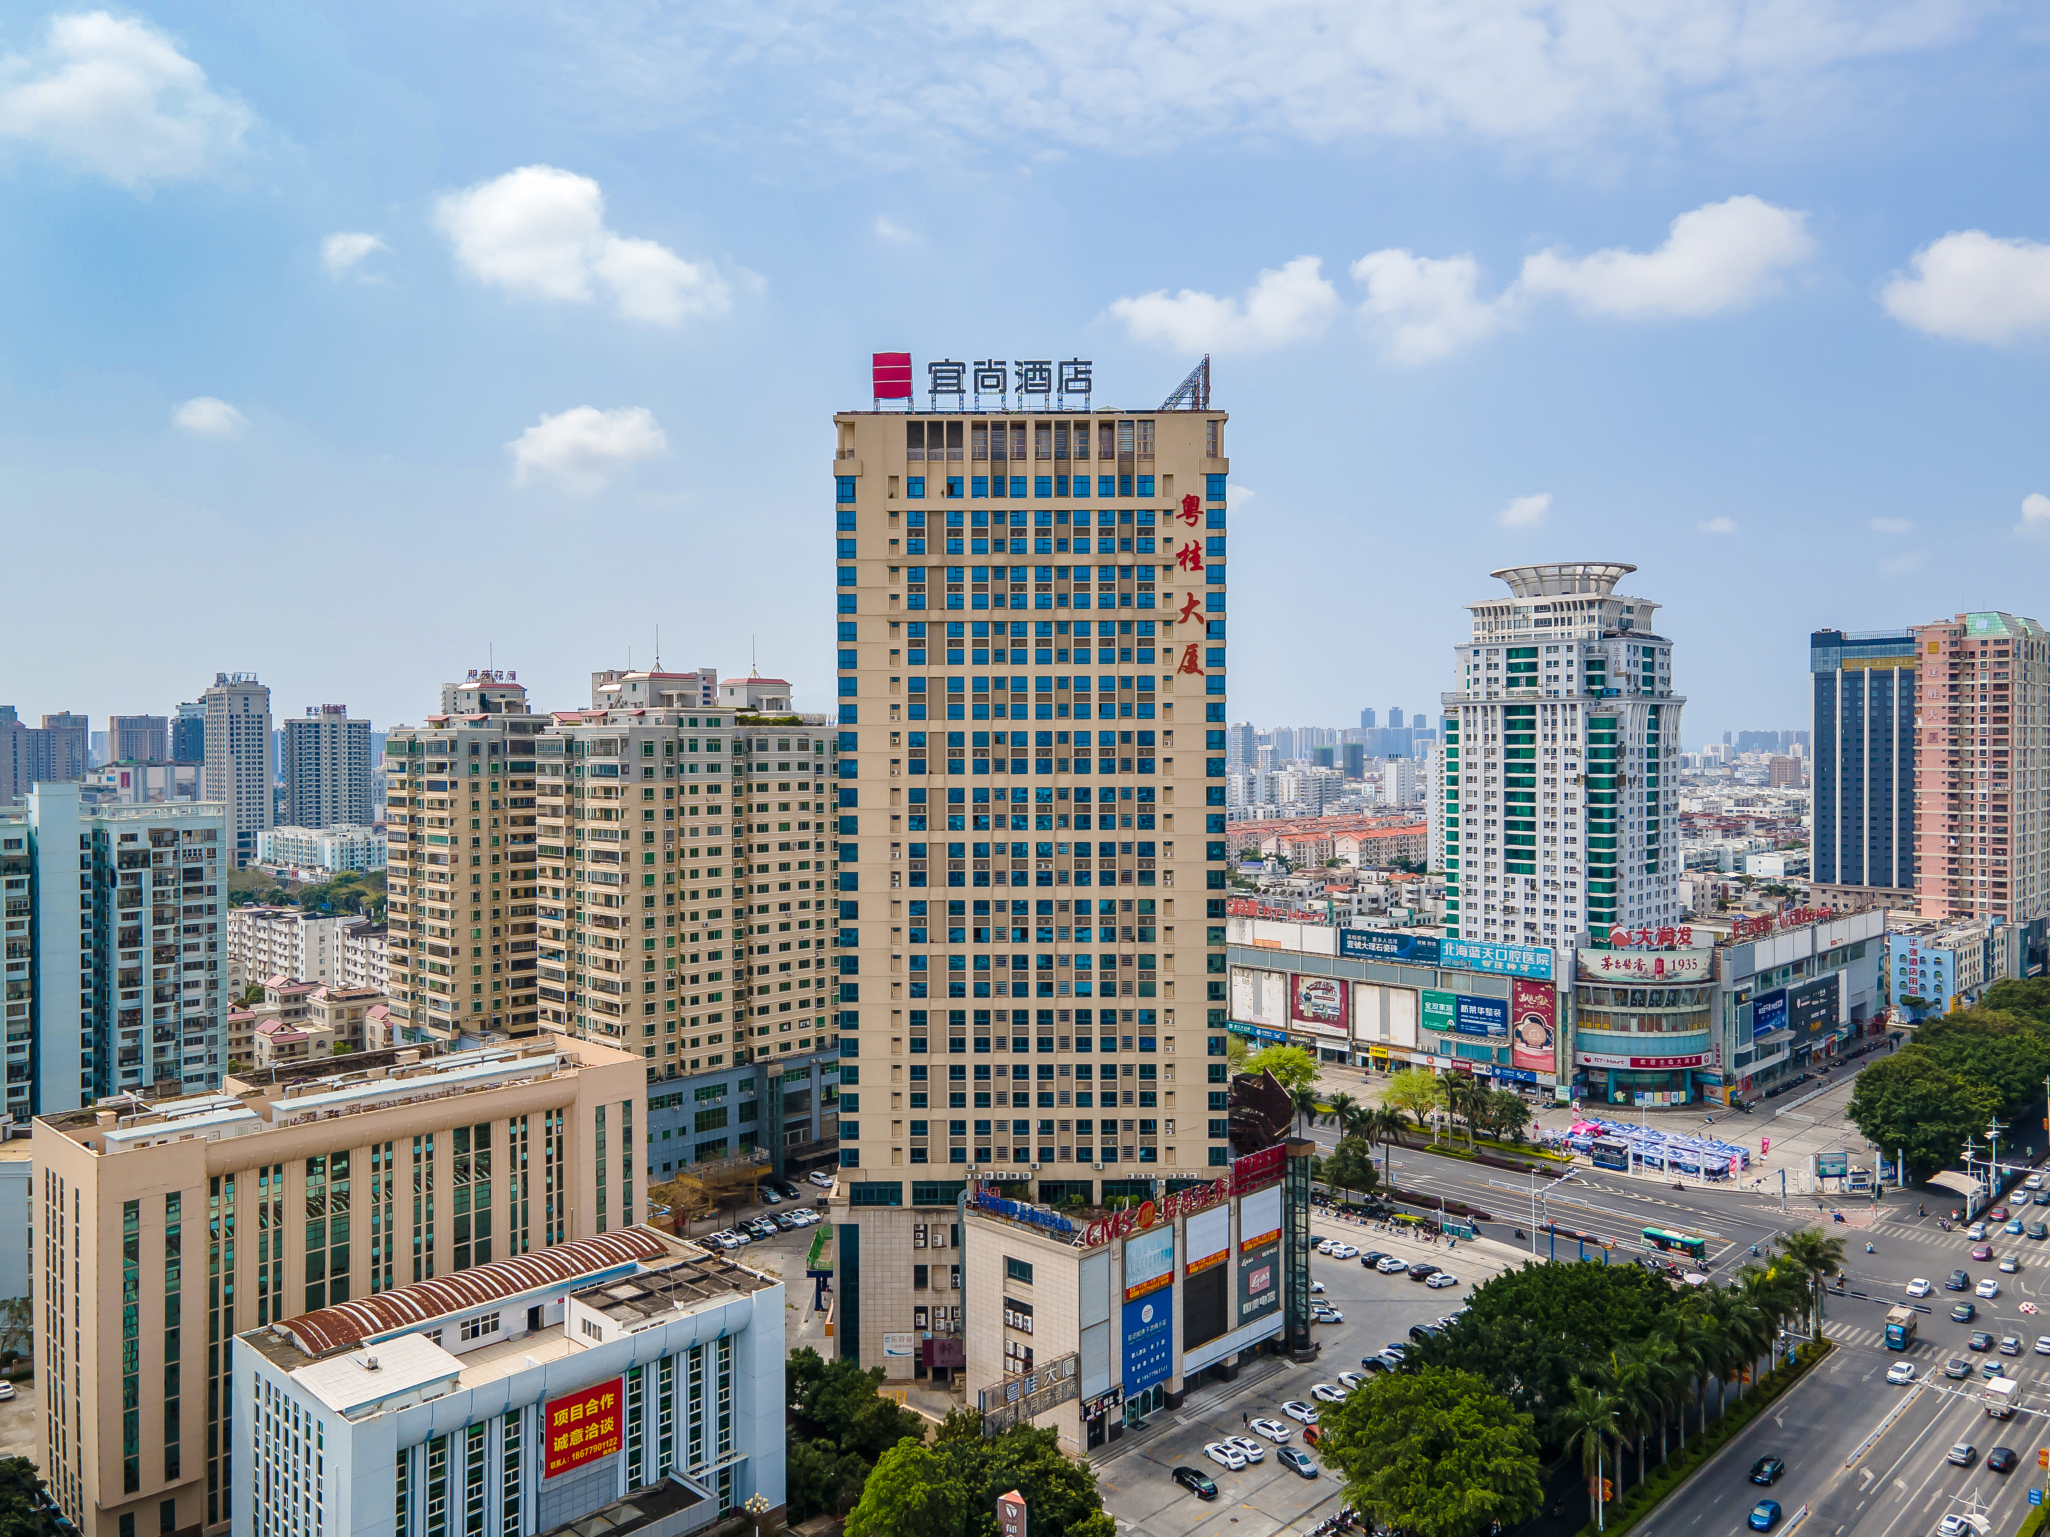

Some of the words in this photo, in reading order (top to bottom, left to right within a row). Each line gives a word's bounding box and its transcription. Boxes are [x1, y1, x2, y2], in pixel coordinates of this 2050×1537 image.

[928, 357, 1092, 394] 宜尚酒店
[1175, 493, 1205, 677] 粤桂大厦
[1442, 941, 1550, 966] 北海蓝天口腔医院
[1635, 926, 1693, 946] 大润发
[1481, 960, 1531, 973] 专注种牙
[1671, 958, 1698, 971] 1935
[1086, 1209, 1133, 1247] CMS
[1161, 1176, 1227, 1222] 招商证券
[1006, 1356, 1075, 1404] 粤桂大厦
[553, 1392, 615, 1427] 项目合作
[553, 1416, 615, 1452] 诚意洽谈
